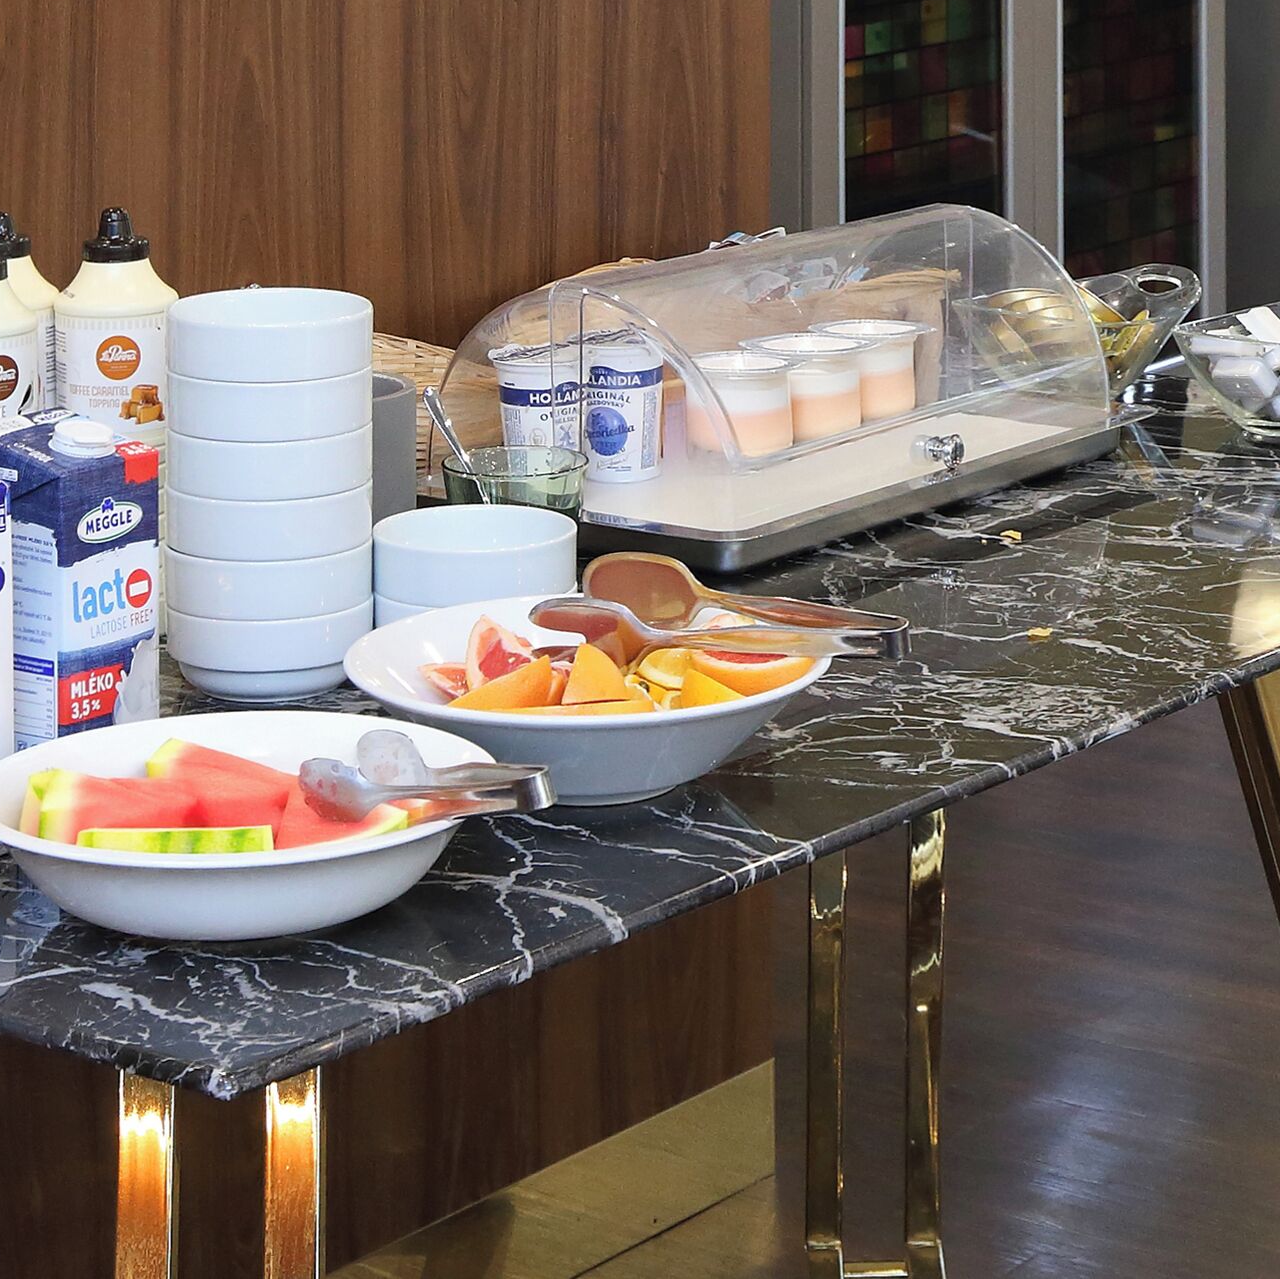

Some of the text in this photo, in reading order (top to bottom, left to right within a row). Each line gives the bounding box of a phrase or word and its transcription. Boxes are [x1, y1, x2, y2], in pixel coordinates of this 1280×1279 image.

[588, 374, 641, 386] LANDIA
[91, 385, 130, 397] CARAMEL
[88, 398, 120, 409] TOPPING
[85, 509, 133, 535] MEGGLE
[90, 615, 127, 640] LACTOSE
[70, 672, 114, 700] MLÉKO
